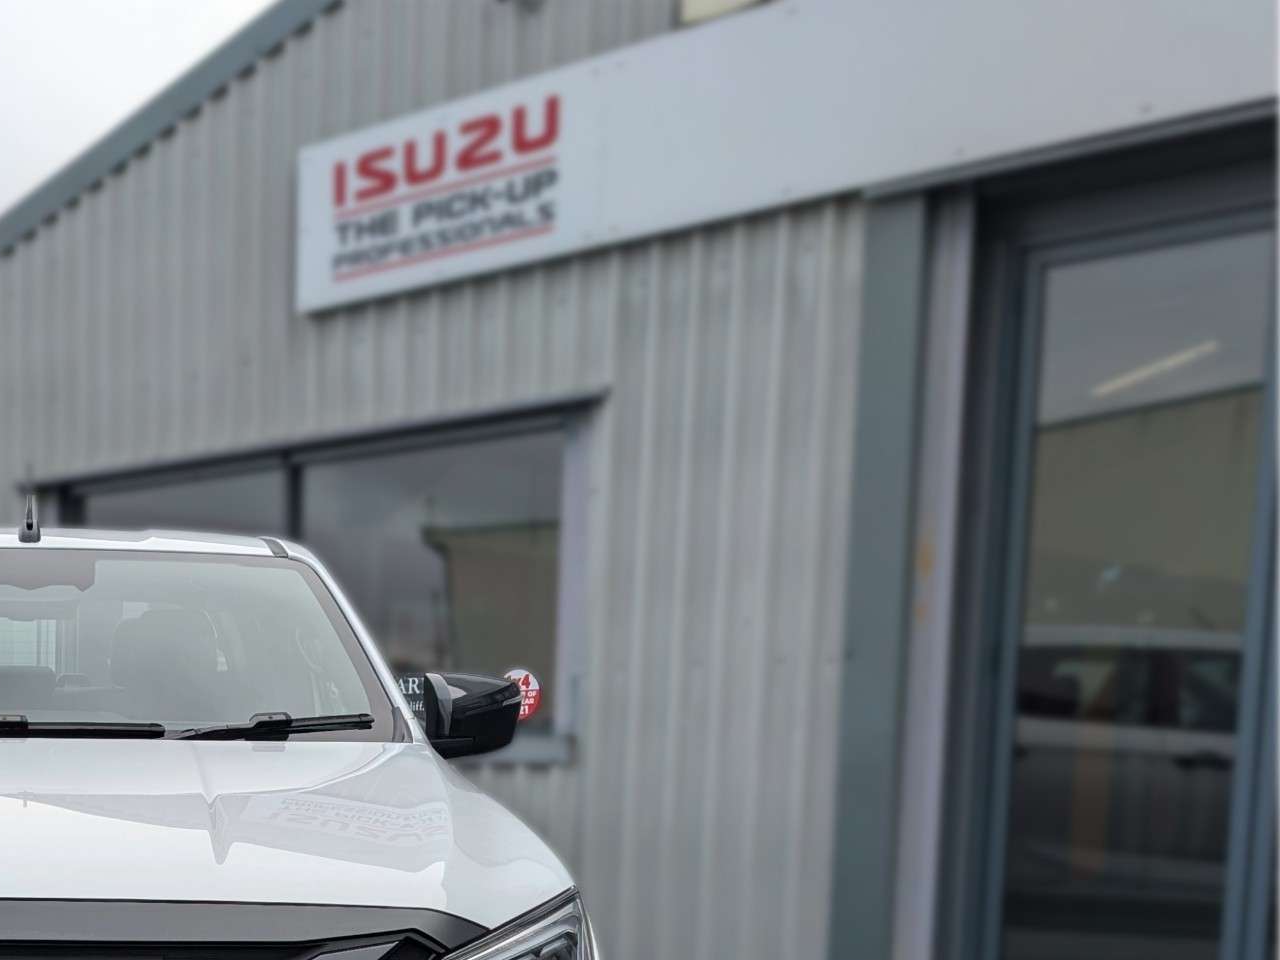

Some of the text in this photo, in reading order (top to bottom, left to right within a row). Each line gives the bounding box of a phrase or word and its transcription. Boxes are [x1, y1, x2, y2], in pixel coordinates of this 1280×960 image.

[332, 94, 560, 208] ISUZU
[332, 202, 556, 271] PROFESSIONALS
[334, 167, 558, 246] THE PICK-UP
